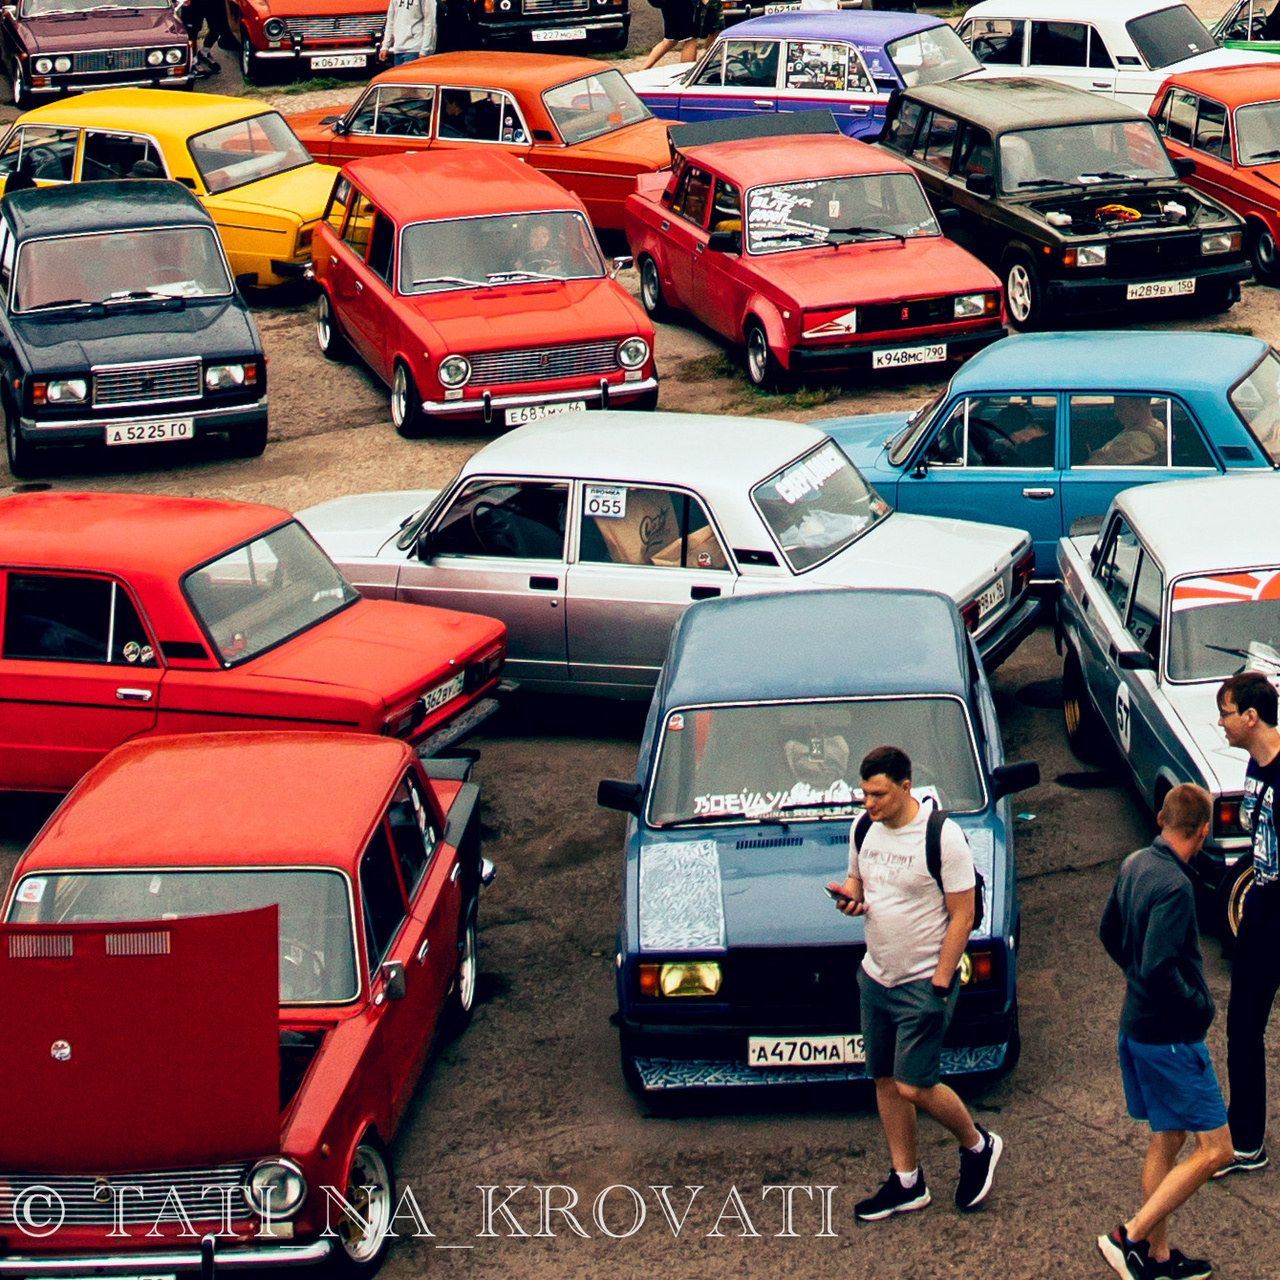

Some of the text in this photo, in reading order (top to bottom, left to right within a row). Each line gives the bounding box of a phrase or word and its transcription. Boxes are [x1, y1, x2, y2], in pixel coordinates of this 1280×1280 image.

[1130, 279, 1193, 298] Н289ВХ 150
[876, 345, 944, 366] К948МС 790
[588, 498, 622, 514] 055
[1117, 695, 1130, 739] 57
[756, 1041, 841, 1062] А470МА
